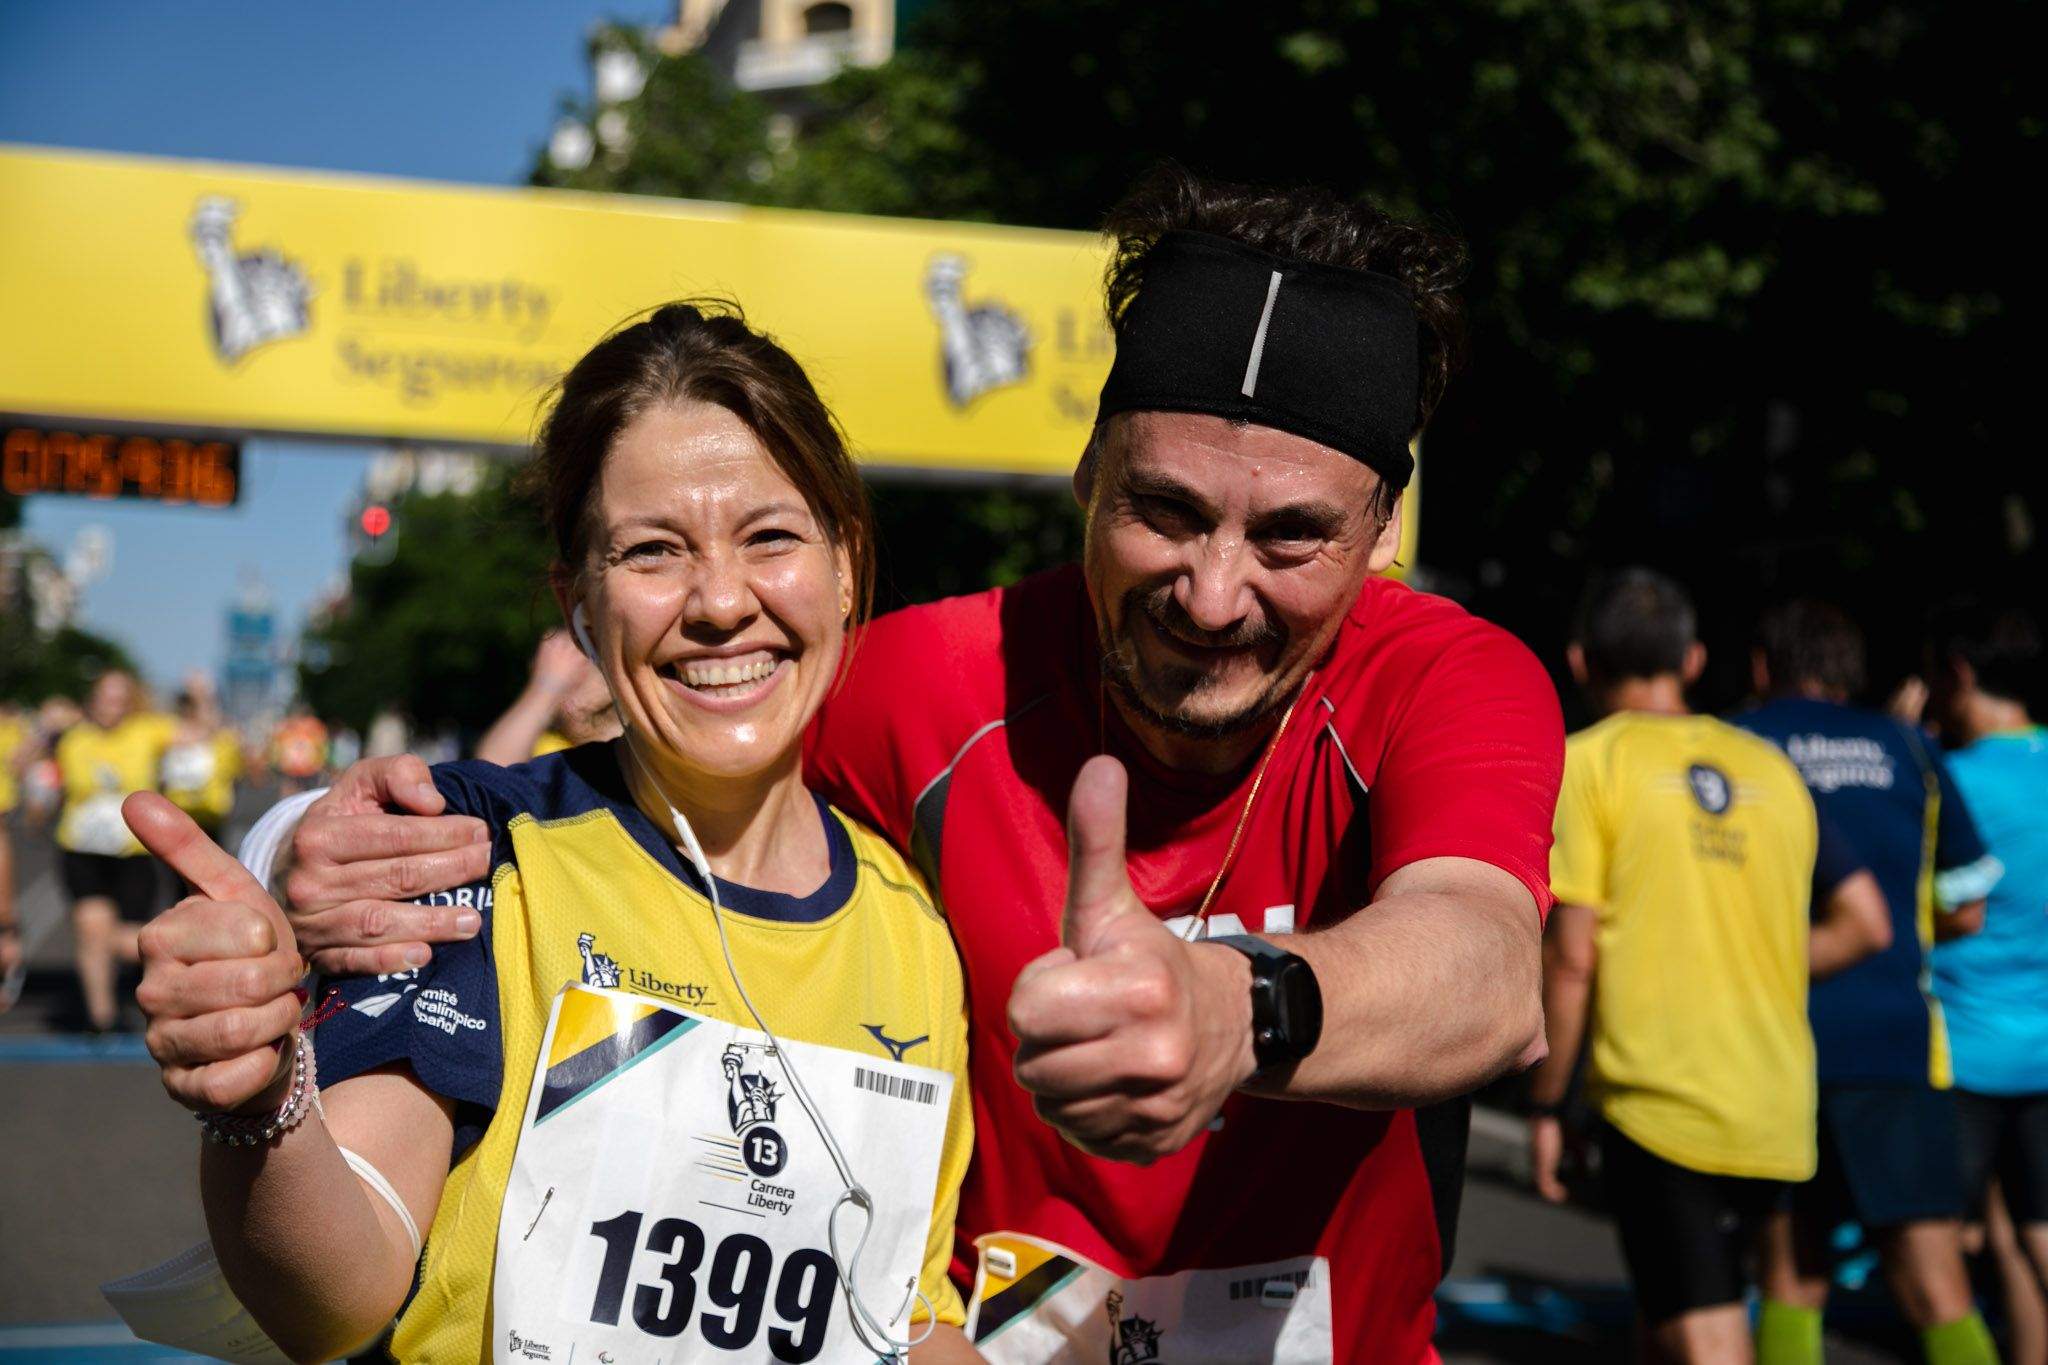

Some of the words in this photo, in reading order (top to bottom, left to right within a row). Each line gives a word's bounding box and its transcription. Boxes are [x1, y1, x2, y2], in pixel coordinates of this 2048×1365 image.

[342, 257, 558, 342] Liberty
[421, 989, 458, 1006] mité
[628, 967, 709, 1006] Liberty
[416, 997, 487, 1030] aralímpico
[417, 1012, 457, 1036] pañol
[751, 1136, 779, 1167] 13
[750, 1179, 796, 1200] Carrera
[747, 1192, 792, 1216] Liberty
[589, 1209, 840, 1365] 1399
[523, 1339, 550, 1353] Liberty
